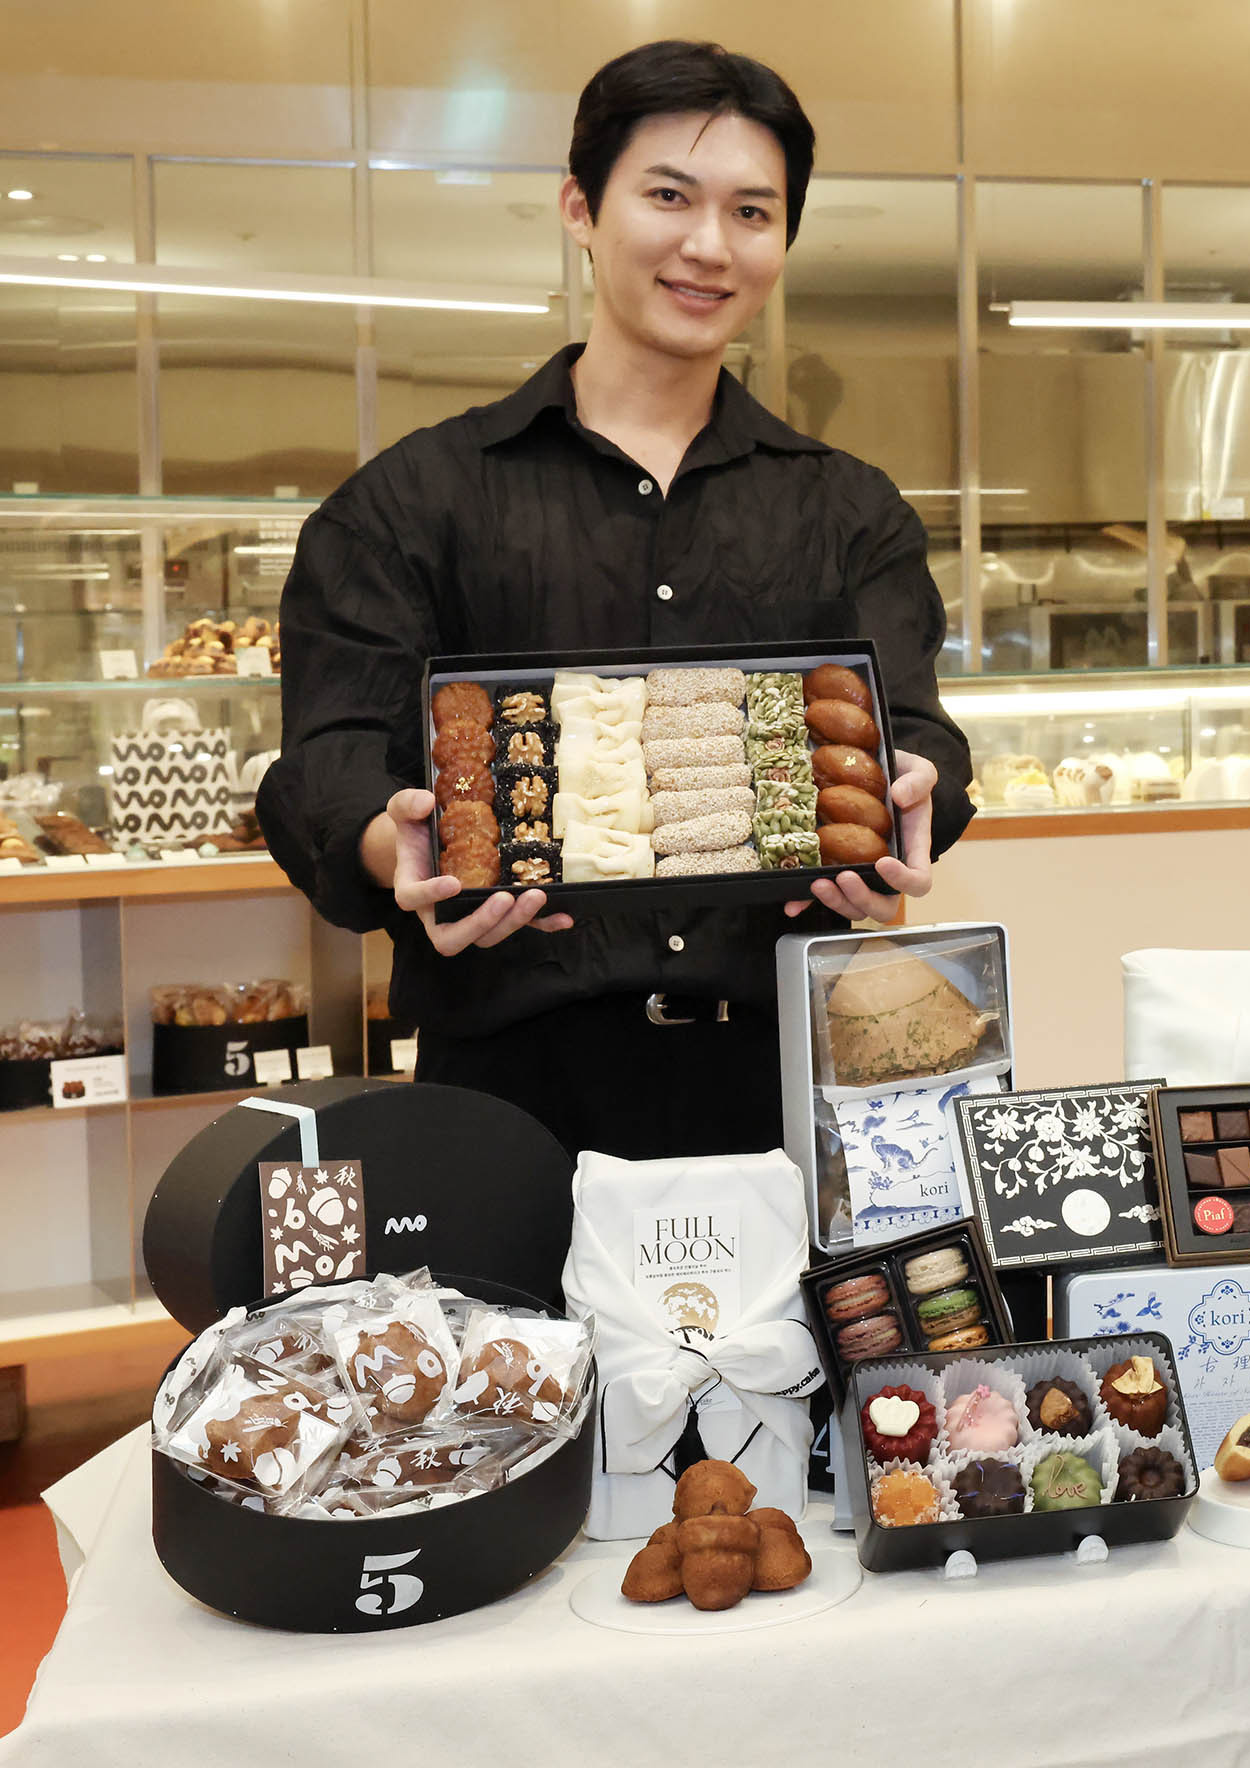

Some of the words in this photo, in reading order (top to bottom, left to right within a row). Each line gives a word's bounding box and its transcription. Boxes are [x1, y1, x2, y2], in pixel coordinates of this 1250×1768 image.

[224, 1041, 250, 1076] 5
[333, 1166, 357, 1188] 秋
[920, 1181, 949, 1197] kori
[1203, 1207, 1225, 1221] Piaf
[656, 1215, 721, 1241] FULL
[640, 1237, 735, 1265] MOON
[1210, 1309, 1245, 1326] kori
[1042, 1454, 1088, 1499] love
[355, 1548, 424, 1615] 5
